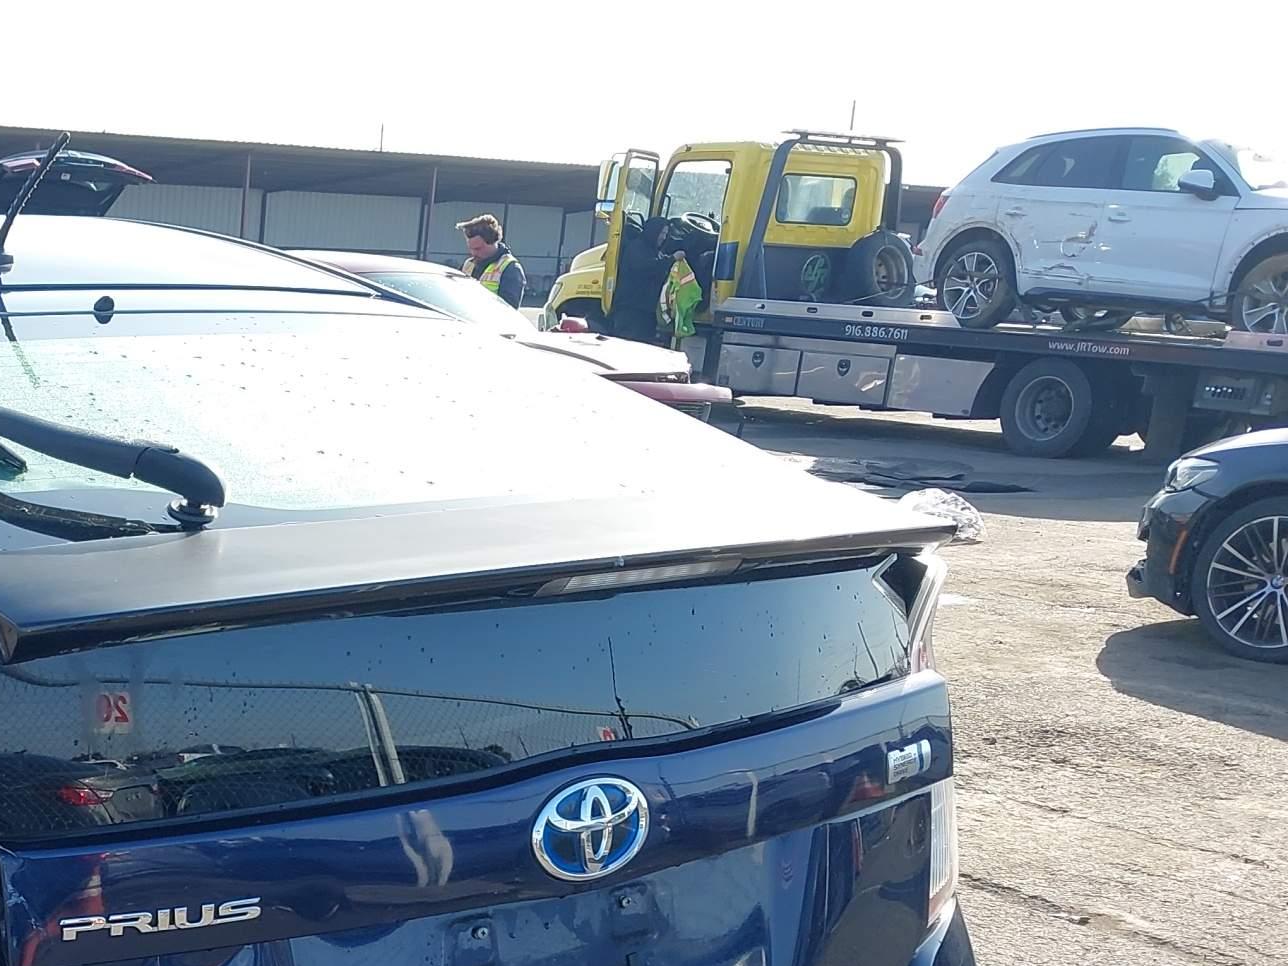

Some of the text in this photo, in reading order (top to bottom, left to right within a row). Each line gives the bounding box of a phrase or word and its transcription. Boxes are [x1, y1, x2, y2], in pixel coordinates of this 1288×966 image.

[844, 324, 909, 340] 916.886.7611
[1048, 340, 1130, 356] www.JRTow.com
[60, 897, 261, 941] PRIUS
